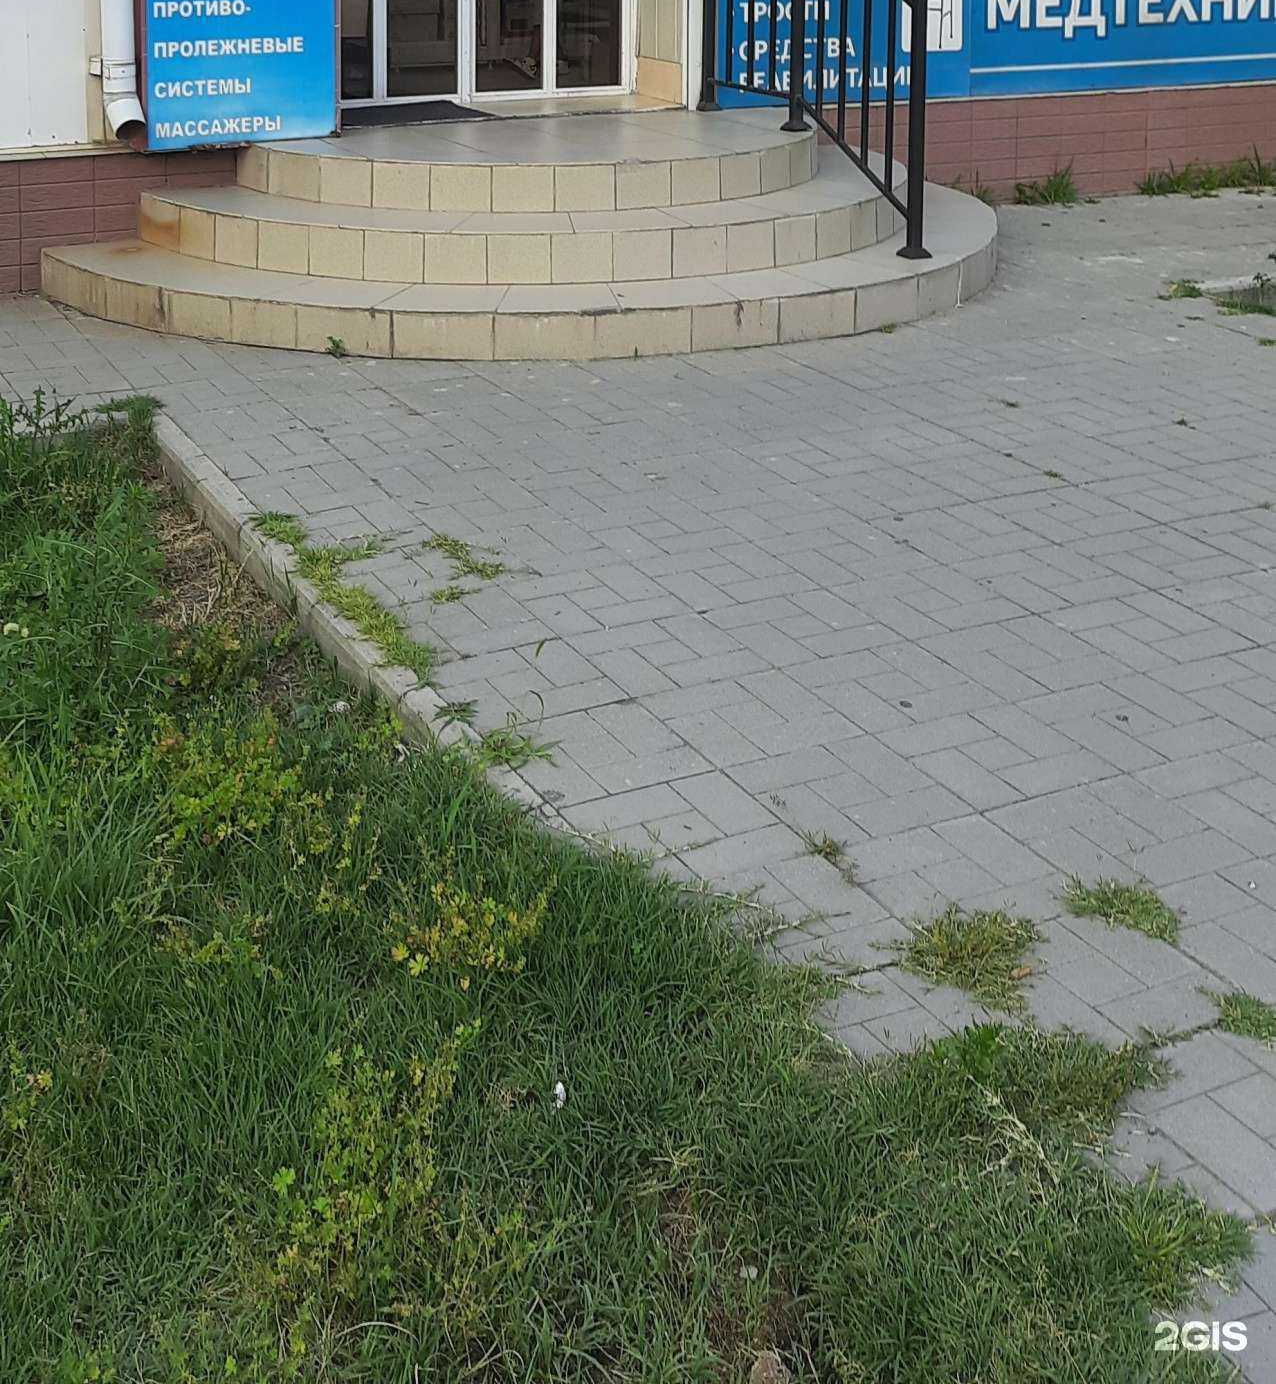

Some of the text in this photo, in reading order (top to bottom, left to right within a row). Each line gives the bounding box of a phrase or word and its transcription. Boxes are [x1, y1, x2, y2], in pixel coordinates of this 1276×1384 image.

[153, 0, 251, 18] ПРОТИВО-
[154, 37, 304, 58] ПРОЛЕЖНЕВЫЕ
[154, 78, 251, 98] СИСТЕМЫ
[155, 115, 281, 139] МАССАЖЕРЫ
